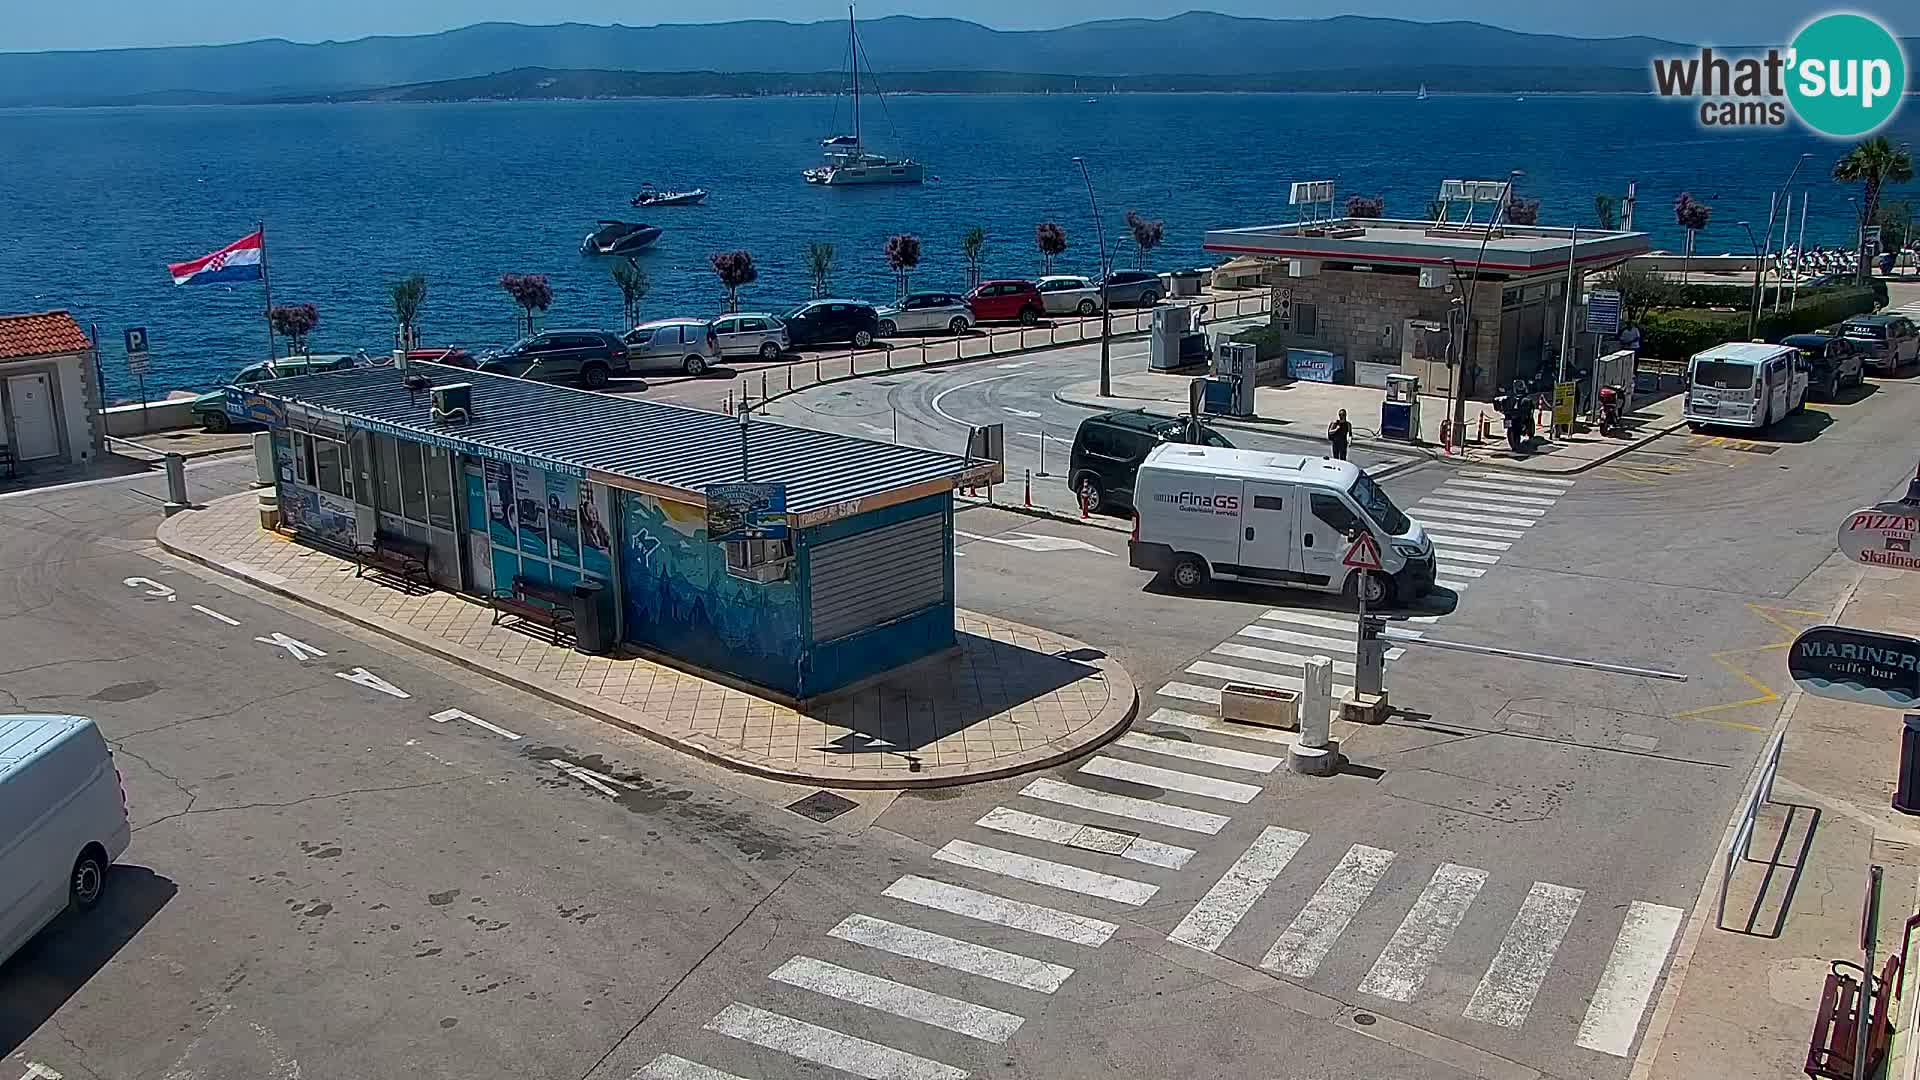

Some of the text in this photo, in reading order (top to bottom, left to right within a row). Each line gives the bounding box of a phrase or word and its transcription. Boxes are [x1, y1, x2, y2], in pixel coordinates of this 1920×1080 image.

[130, 331, 142, 349] P
[437, 437, 468, 452] POSTAJA
[478, 446, 492, 457] BUS
[494, 451, 526, 465] STATION
[529, 458, 554, 472] TICKET
[555, 463, 582, 477] OFFICE
[1179, 491, 1239, 509] FinaGS
[1848, 514, 1920, 533] PIZZE
[1829, 661, 1897, 680] caffe bar
